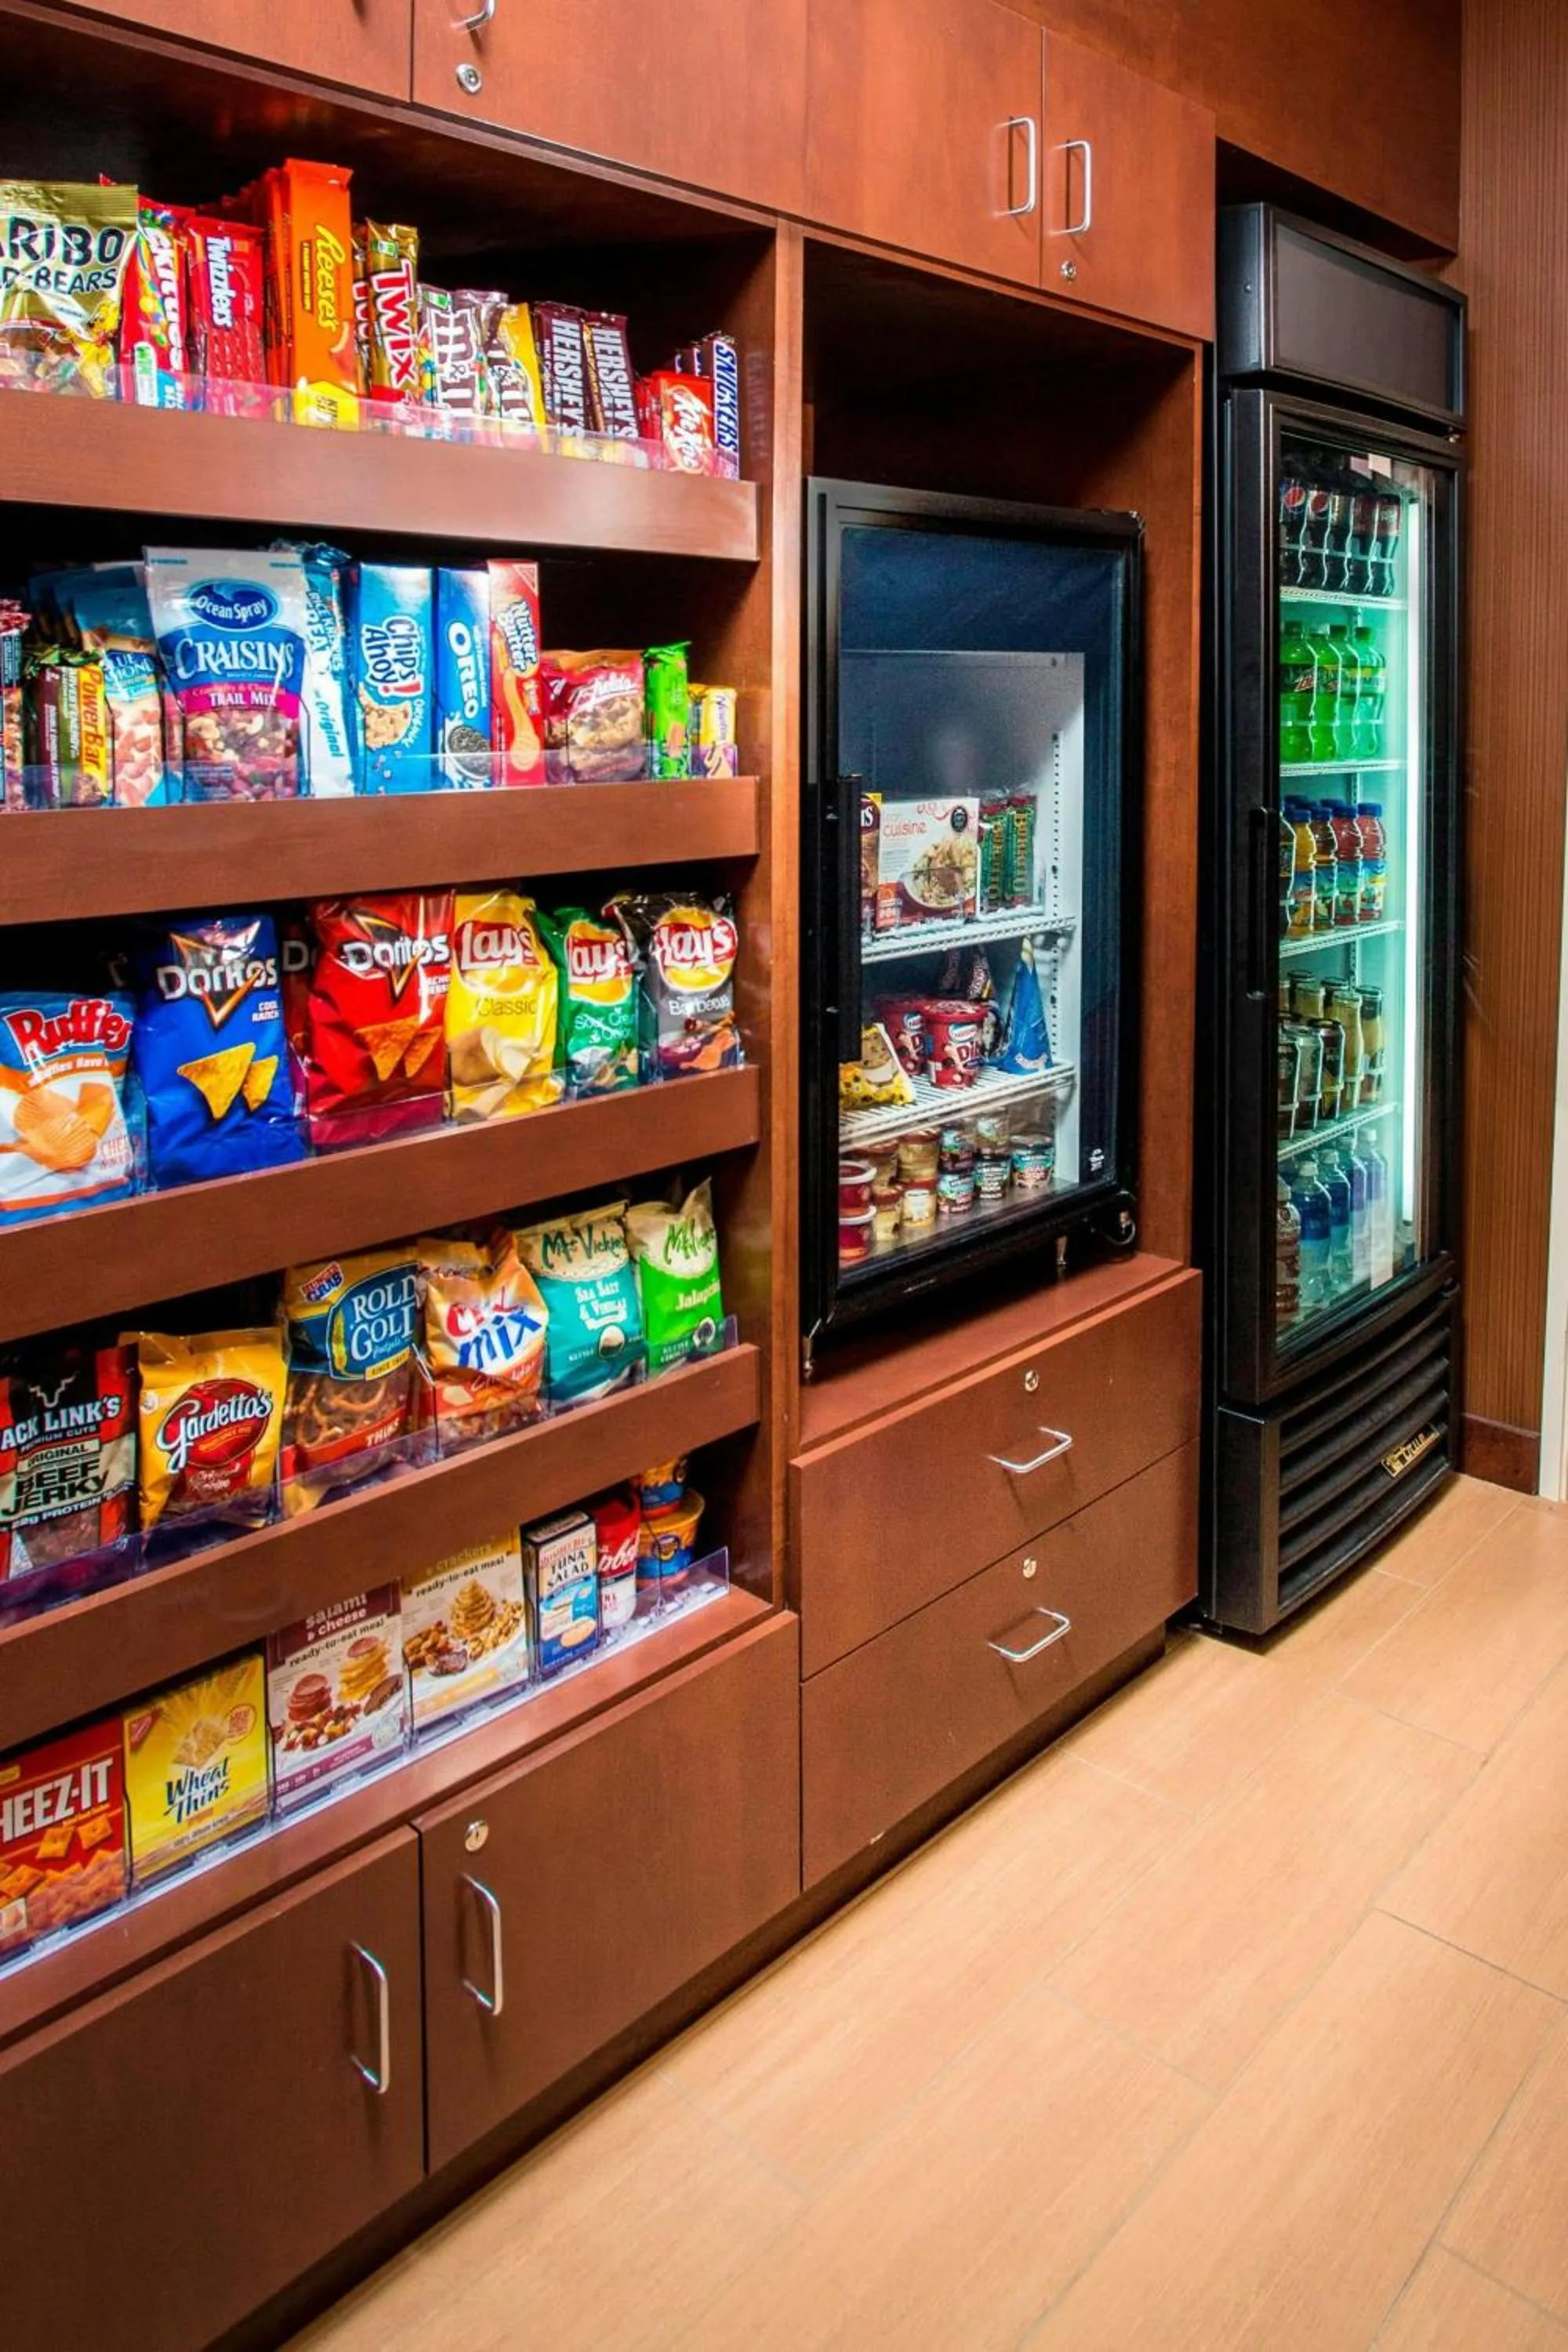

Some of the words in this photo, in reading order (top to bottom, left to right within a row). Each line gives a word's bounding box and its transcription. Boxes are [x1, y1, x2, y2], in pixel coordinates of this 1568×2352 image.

[0, 216, 125, 267] RIBO
[0, 267, 118, 296] D-BEARS
[206, 236, 237, 327] Twizzlers
[315, 224, 345, 332] Reese's
[372, 259, 418, 387] TWIX
[551, 318, 585, 437] HERSHEY'S
[591, 327, 639, 438] HERSHEY'S
[714, 343, 738, 454] SNICKERS
[196, 595, 233, 619] Ocean
[234, 599, 268, 622] Spray
[175, 637, 294, 680] CRAISINS
[365, 626, 421, 693] Ahoy!
[386, 618, 417, 681] Chips
[448, 621, 479, 719] OREO
[82, 668, 105, 770] PowerBar
[315, 701, 344, 759] Original
[883, 821, 927, 837] cuisine
[343, 934, 450, 971] Doritos
[157, 957, 278, 1000] Doritos
[352, 1275, 419, 1323] ROLD
[1, 1416, 39, 1450] ACK
[44, 1396, 120, 1432] LINK'S
[157, 1388, 273, 1474] Gardetto's
[1, 1470, 109, 1515] JERKY
[16, 1457, 100, 1496] BEEF
[42, 1495, 102, 1520] PROTEIN
[416, 1566, 479, 1598] ready-to-eat
[481, 1555, 505, 1570] meal
[546, 1562, 589, 1588] SALAD
[551, 1550, 586, 1574] TUNA
[306, 1593, 368, 1630] salami
[318, 1609, 367, 1637] cheese
[289, 1631, 358, 1668] ready-to-eat
[360, 1619, 386, 1635] meal
[0, 1757, 114, 1842] HEEZ-IT
[163, 1778, 230, 1824] Thins
[166, 1755, 230, 1806] Wheat
